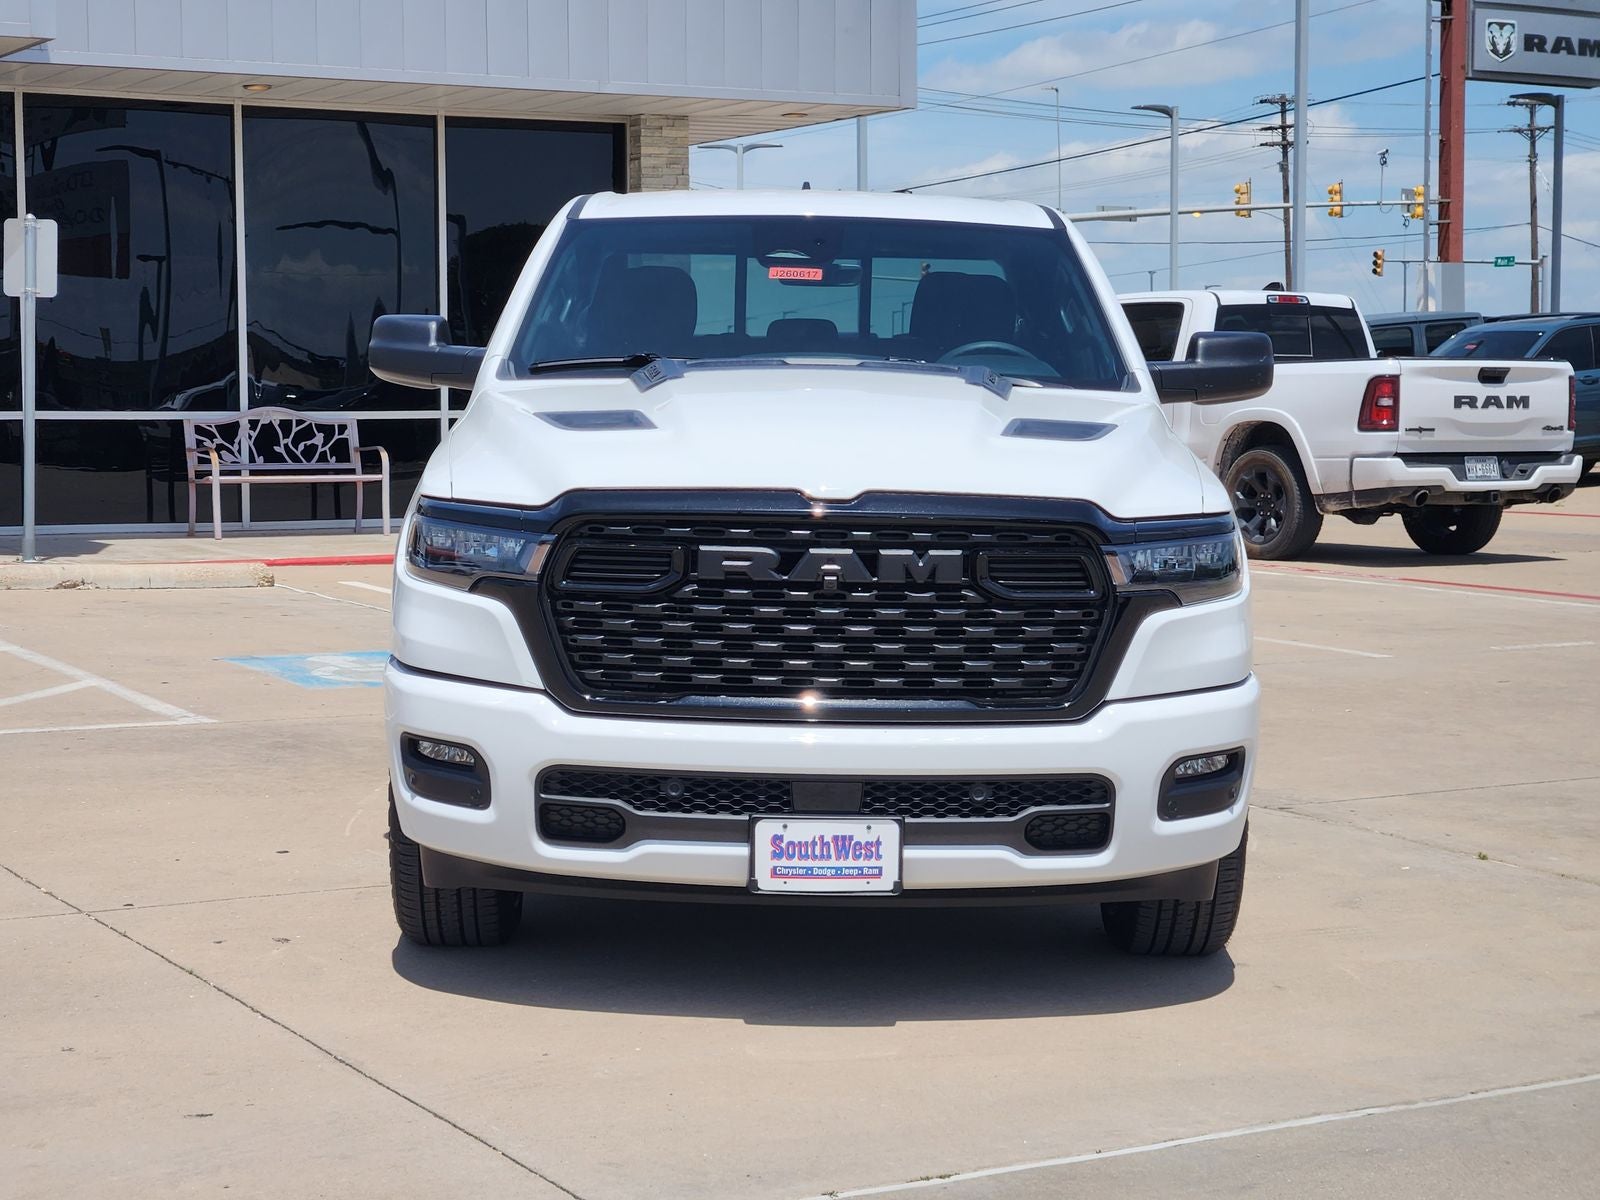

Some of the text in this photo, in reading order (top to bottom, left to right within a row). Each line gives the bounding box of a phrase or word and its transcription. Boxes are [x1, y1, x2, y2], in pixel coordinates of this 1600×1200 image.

[1523, 33, 1600, 58] RAM
[772, 269, 818, 279] J260617
[1453, 395, 1530, 409] RAM
[699, 545, 963, 584] RAM
[776, 866, 806, 876] Chrysler
[813, 867, 836, 876] Dodge
[841, 867, 858, 876] Jeep
